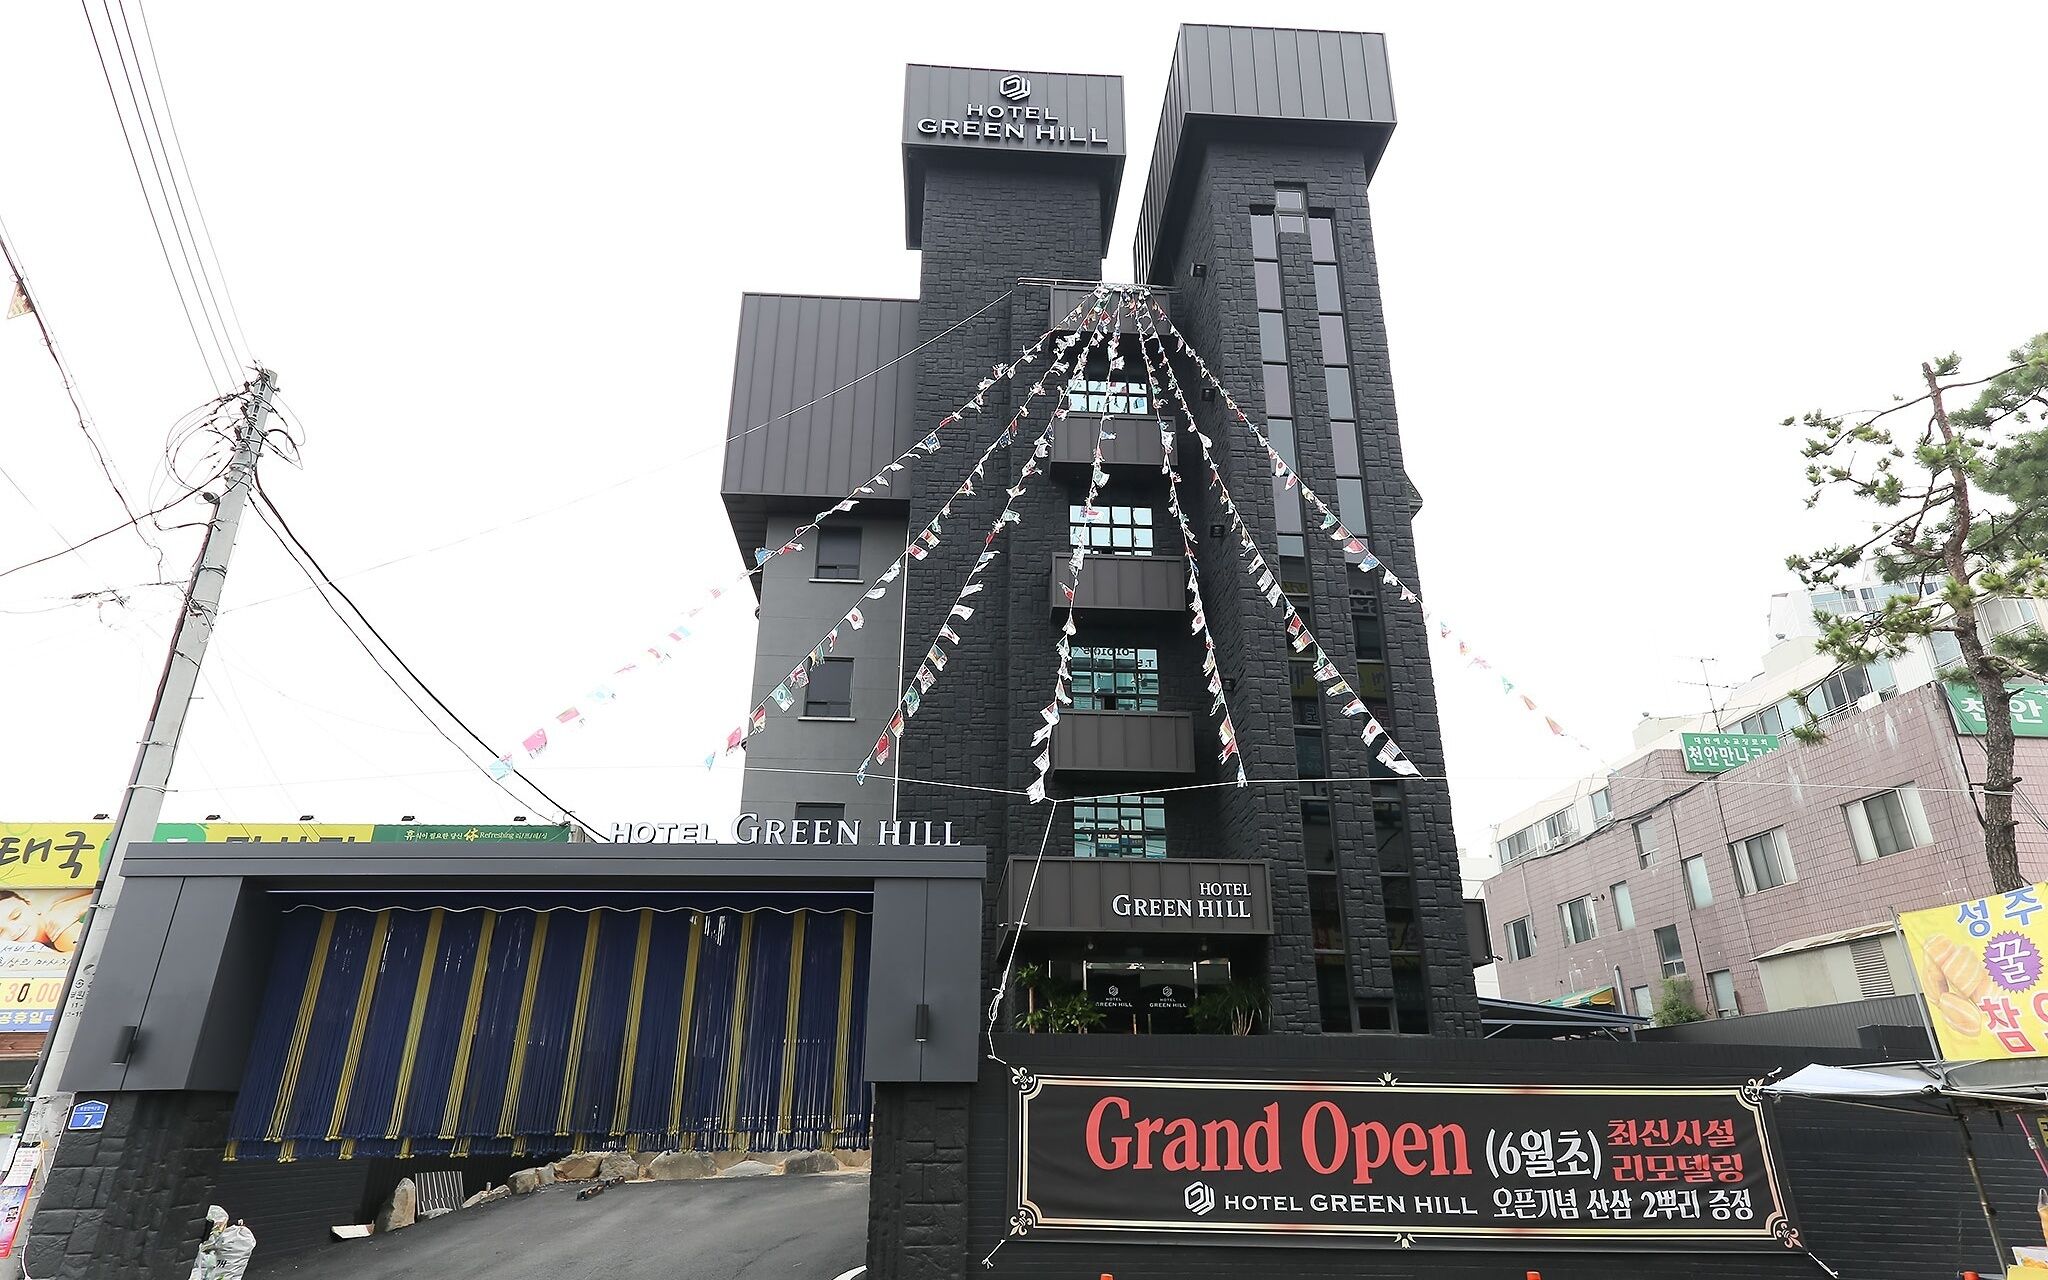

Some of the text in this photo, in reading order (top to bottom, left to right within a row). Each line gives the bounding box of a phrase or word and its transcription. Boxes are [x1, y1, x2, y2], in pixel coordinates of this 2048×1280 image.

[967, 103, 1059, 122] HOTEL
[917, 118, 1108, 144] GREEN HILL
[1688, 745, 1777, 767] 천안만나교
[609, 813, 962, 846] HOTEL GREEN HILL
[0, 831, 95, 879] 태국
[1199, 882, 1252, 896] HOTEL
[1112, 894, 1251, 918] GREEN HILL
[1957, 886, 2043, 937] 성주
[1988, 938, 2032, 985] 꿀
[82, 1114, 93, 1126] 7
[1606, 1118, 1737, 1148] 최신시설
[1085, 1096, 1602, 1184] Grand Open (6월초)
[1612, 1152, 1745, 1183] 리모델링
[1224, 1193, 1478, 1215] HOTEL GREEN HILL
[1492, 1187, 1754, 1220] 오픈기념 산삼 2뿌리 증정
